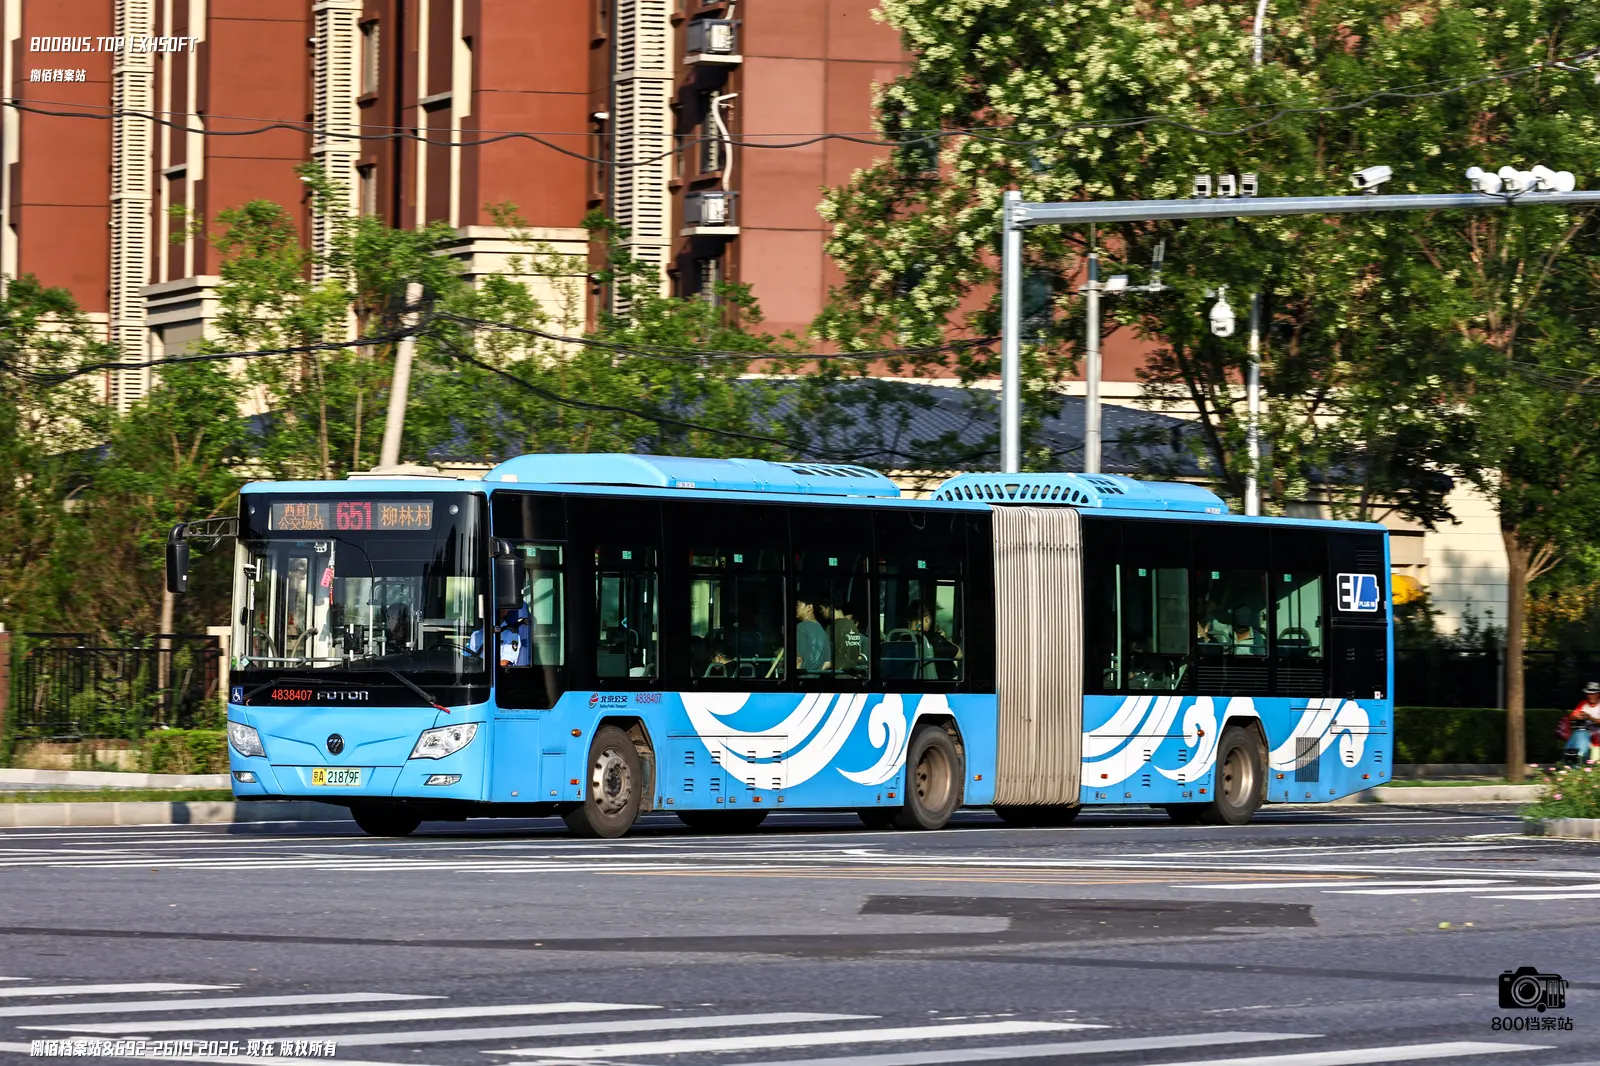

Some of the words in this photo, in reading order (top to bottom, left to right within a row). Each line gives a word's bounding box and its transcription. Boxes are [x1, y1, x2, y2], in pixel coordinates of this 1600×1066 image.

[336, 502, 372, 530] 651
[381, 505, 432, 527] 柳林村
[271, 689, 313, 701] 4838407
[317, 690, 369, 701] FOTON
[600, 695, 628, 703] 北京公交
[635, 693, 662, 704] 4838407
[327, 771, 360, 783] 21879F
